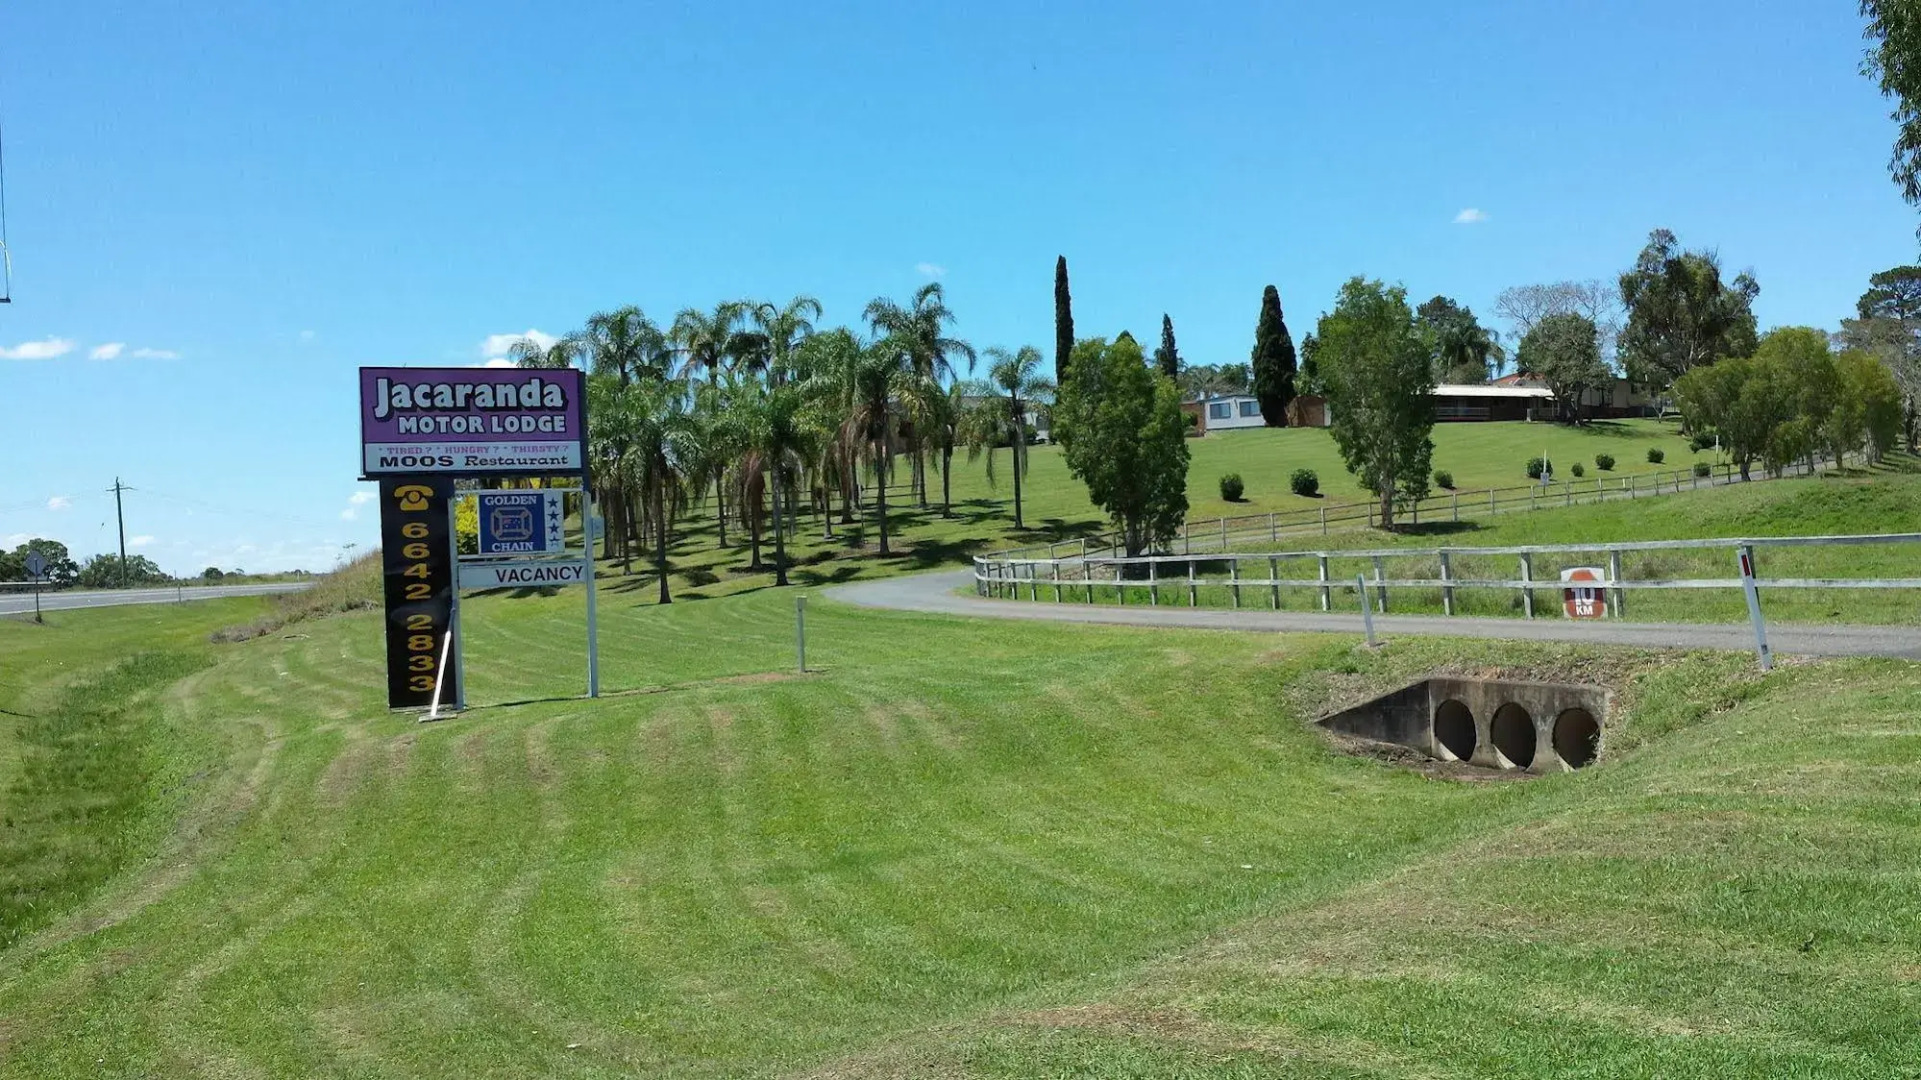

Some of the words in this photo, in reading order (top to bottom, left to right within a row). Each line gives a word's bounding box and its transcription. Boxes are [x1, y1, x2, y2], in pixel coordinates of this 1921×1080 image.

[374, 377, 565, 419] Jacaranda
[398, 415, 485, 434] MOTOR
[491, 415, 566, 433] LODGE
[380, 456, 454, 467] MOOS
[464, 455, 568, 466] Restaurant
[484, 495, 537, 506] GOLDEN
[491, 541, 534, 552] CHAIN
[496, 565, 583, 583] VACANCY
[1576, 605, 1593, 615] KM
